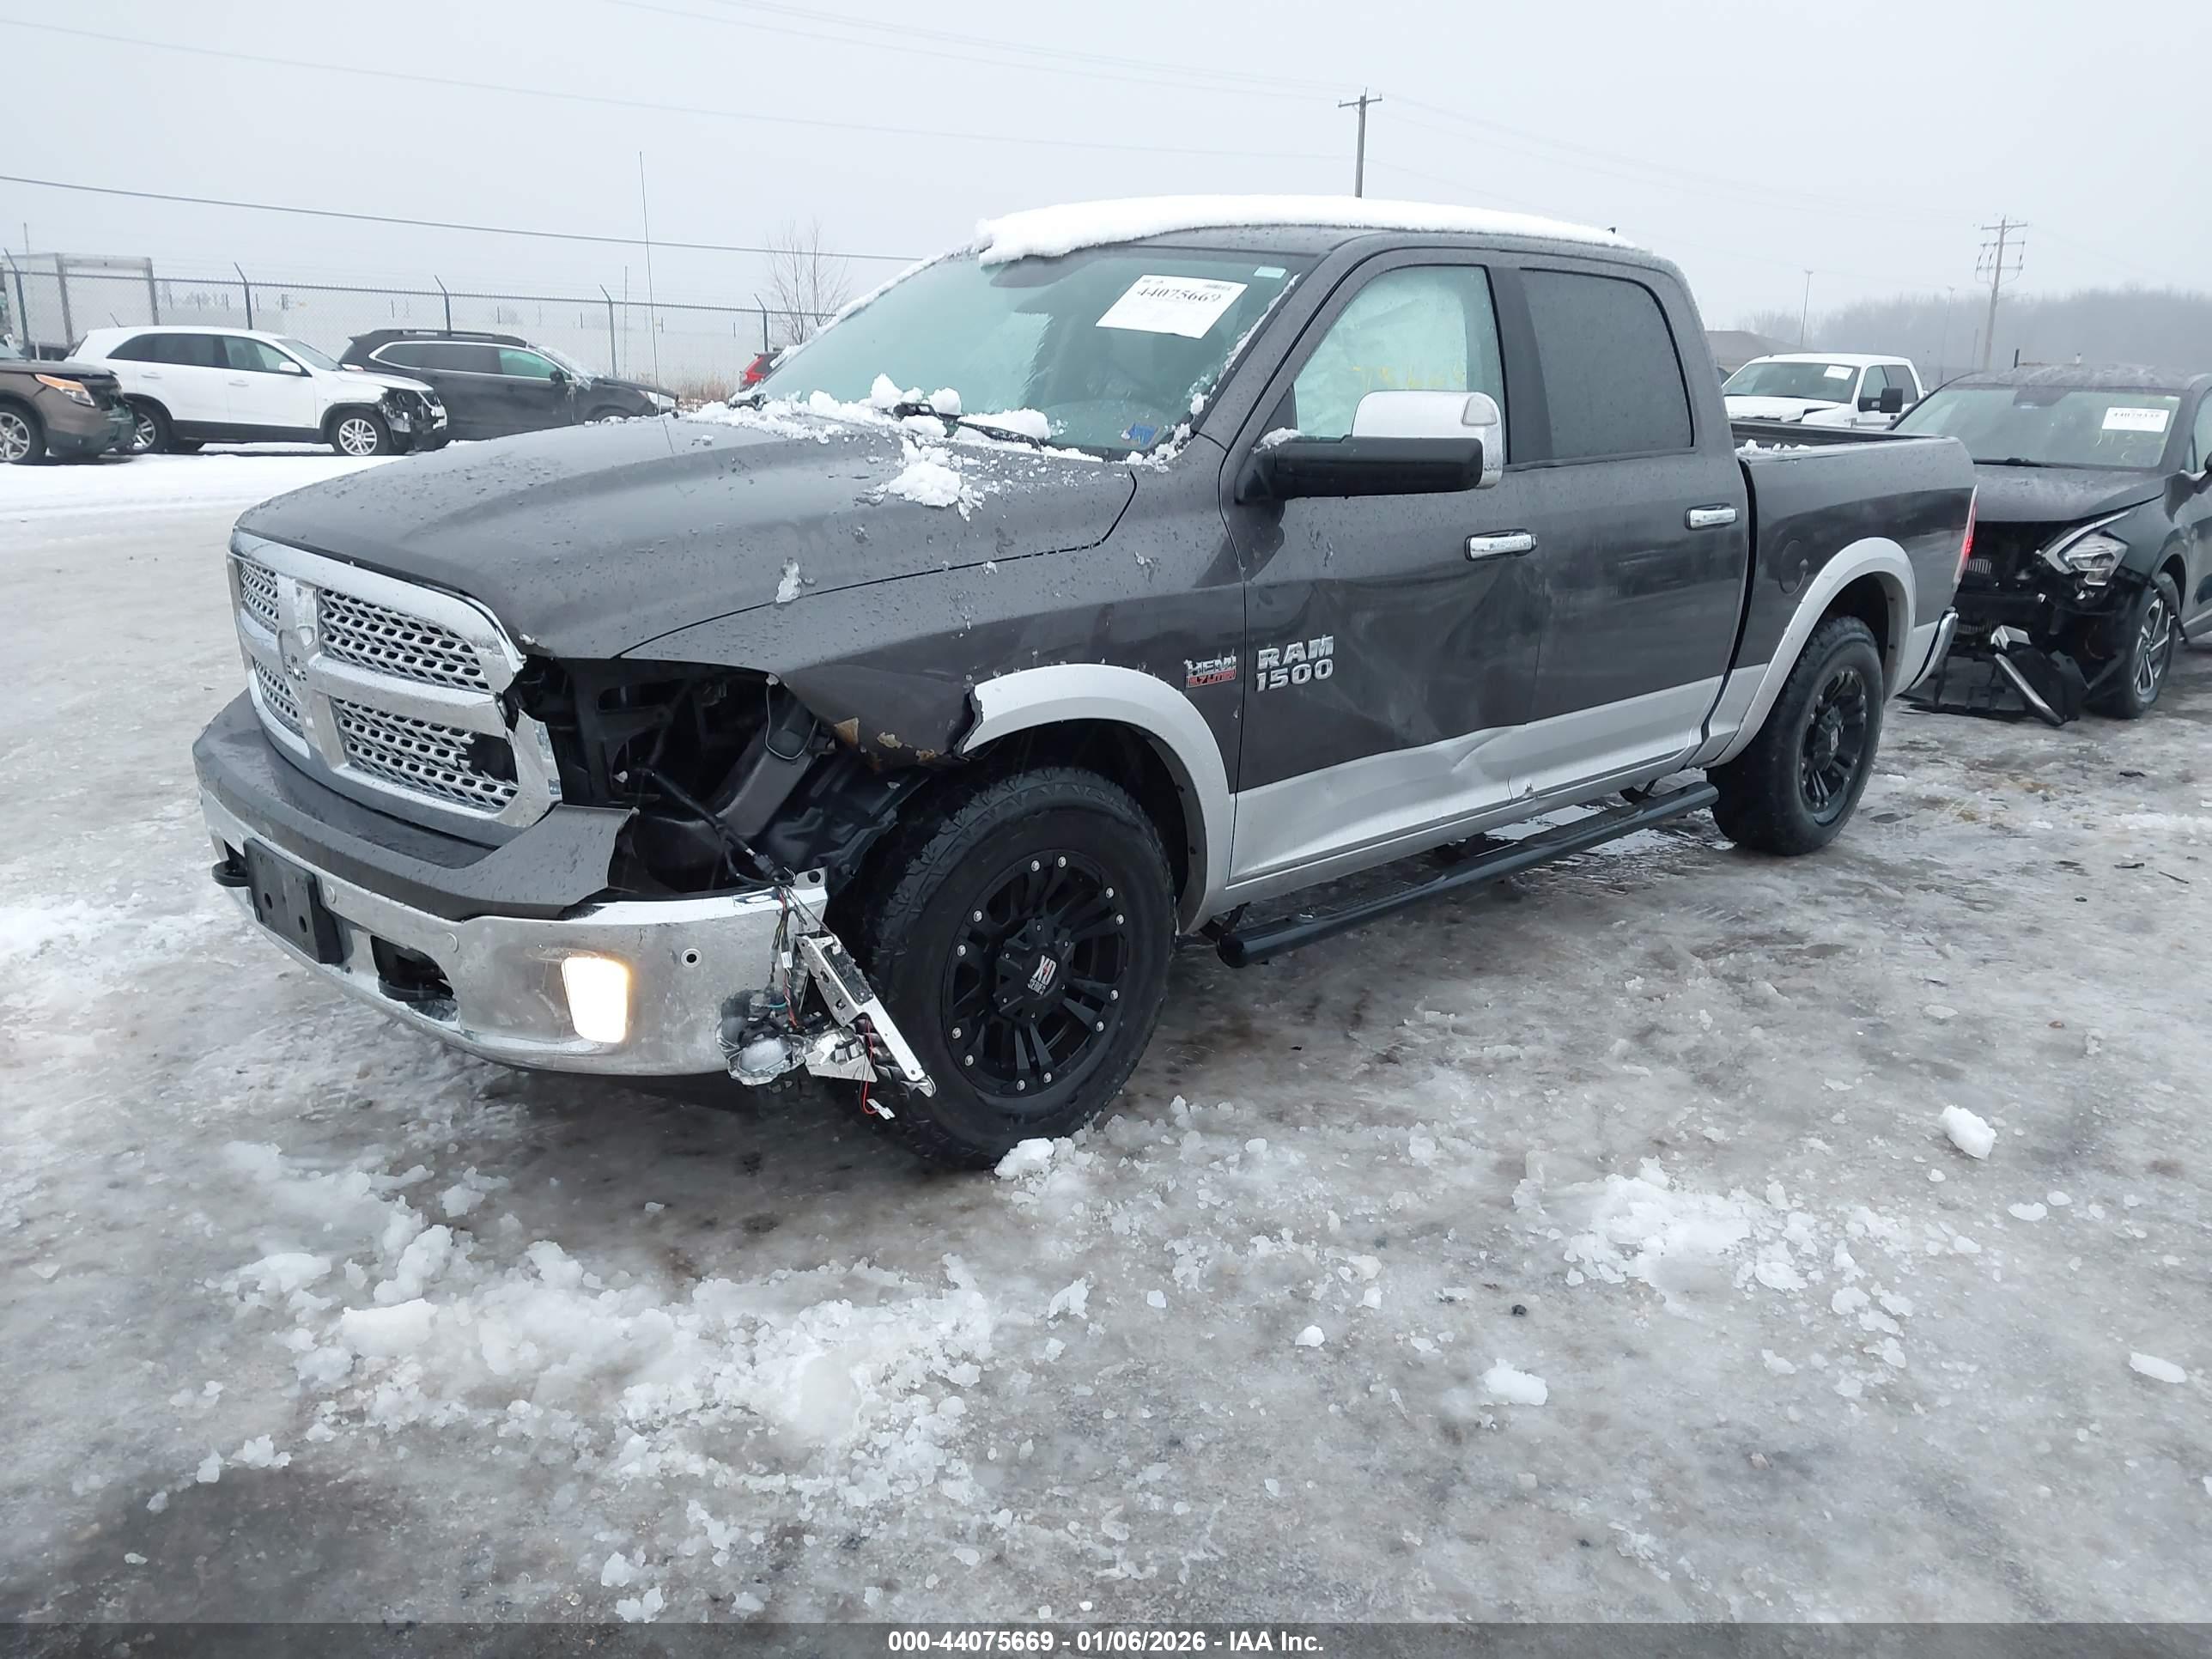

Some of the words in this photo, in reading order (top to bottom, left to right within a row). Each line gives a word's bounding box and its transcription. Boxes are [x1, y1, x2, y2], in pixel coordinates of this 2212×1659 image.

[1136, 288, 1221, 302] 44075669
[1258, 635, 1334, 670] RAM
[1184, 656, 1237, 676] HEMI
[1256, 659, 1334, 692] 1500
[1032, 955, 1057, 986] XD
[1028, 978, 1047, 996] SERIES
